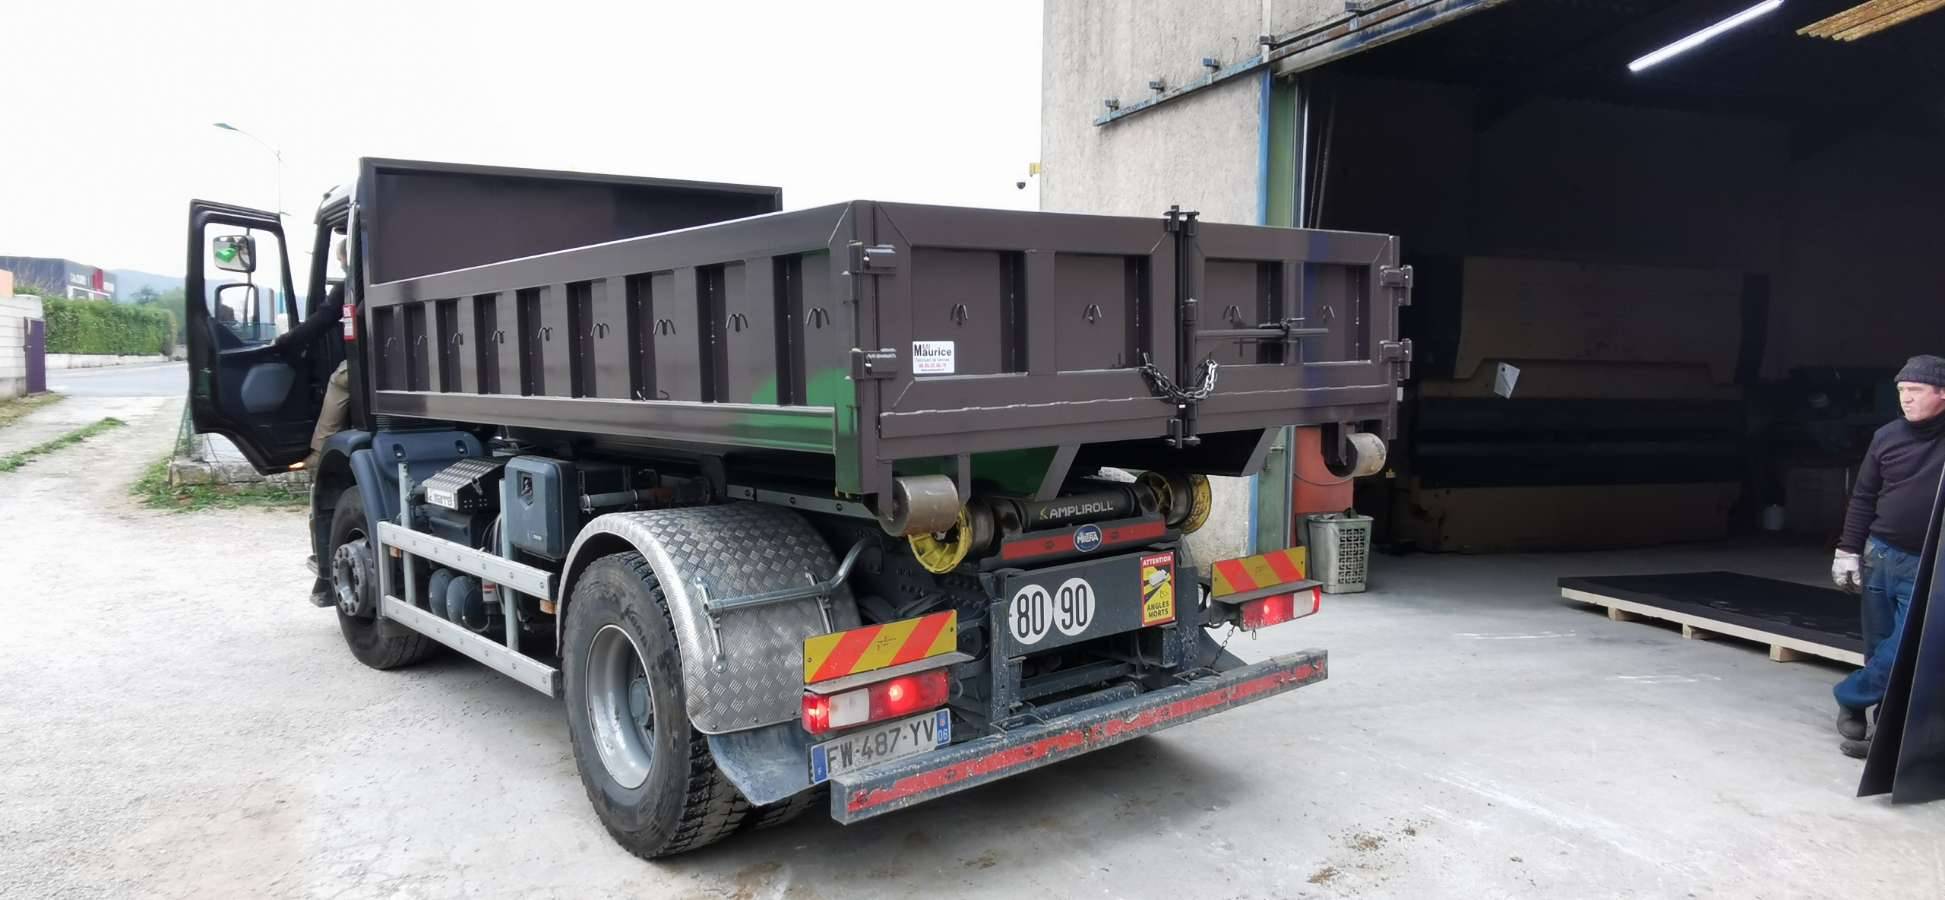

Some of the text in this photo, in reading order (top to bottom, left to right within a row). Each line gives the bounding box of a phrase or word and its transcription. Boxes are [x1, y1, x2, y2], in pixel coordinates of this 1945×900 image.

[914, 344, 952, 356] Maurice
[1050, 502, 1113, 519] AMPLIROLL
[1143, 556, 1171, 566] ATTENTION
[1061, 584, 1088, 630] 90
[1147, 601, 1169, 611] ANGLES
[1017, 591, 1045, 638] 80
[1149, 608, 1169, 617] MORTS
[938, 728, 948, 740] 06
[827, 718, 934, 768] FW-487-YV
